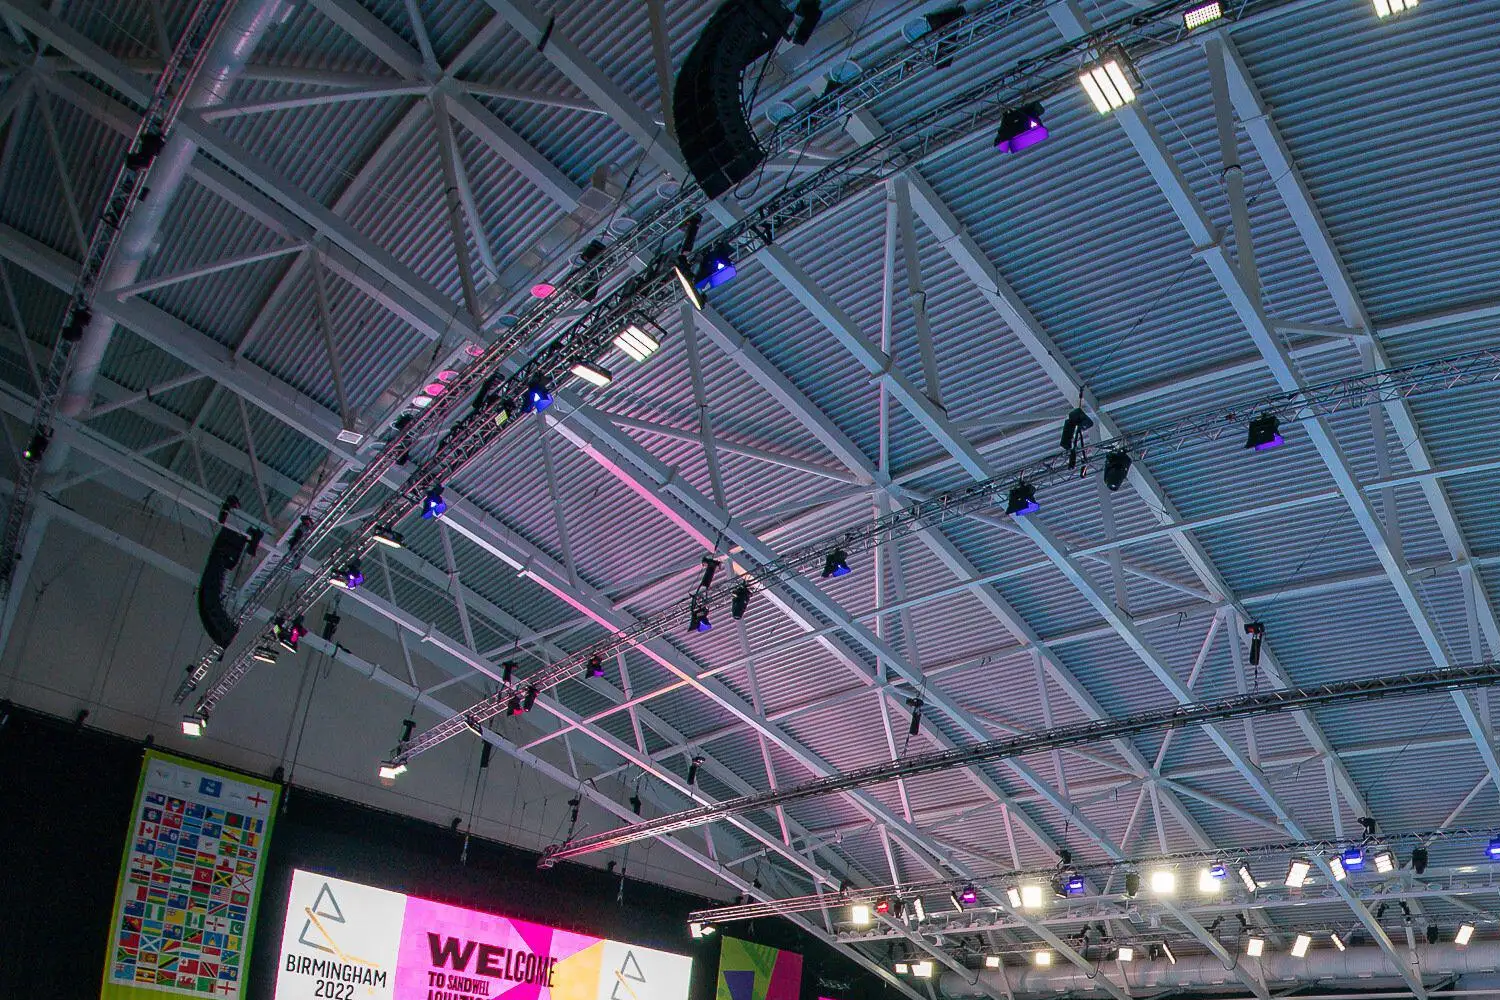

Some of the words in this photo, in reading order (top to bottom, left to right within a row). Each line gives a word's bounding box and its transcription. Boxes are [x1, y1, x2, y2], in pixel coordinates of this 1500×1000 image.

[285, 953, 388, 988] BIRMINGHAM
[427, 932, 558, 988] WELCOME
[427, 971, 447, 987] TO
[447, 974, 490, 996] SANDWELL
